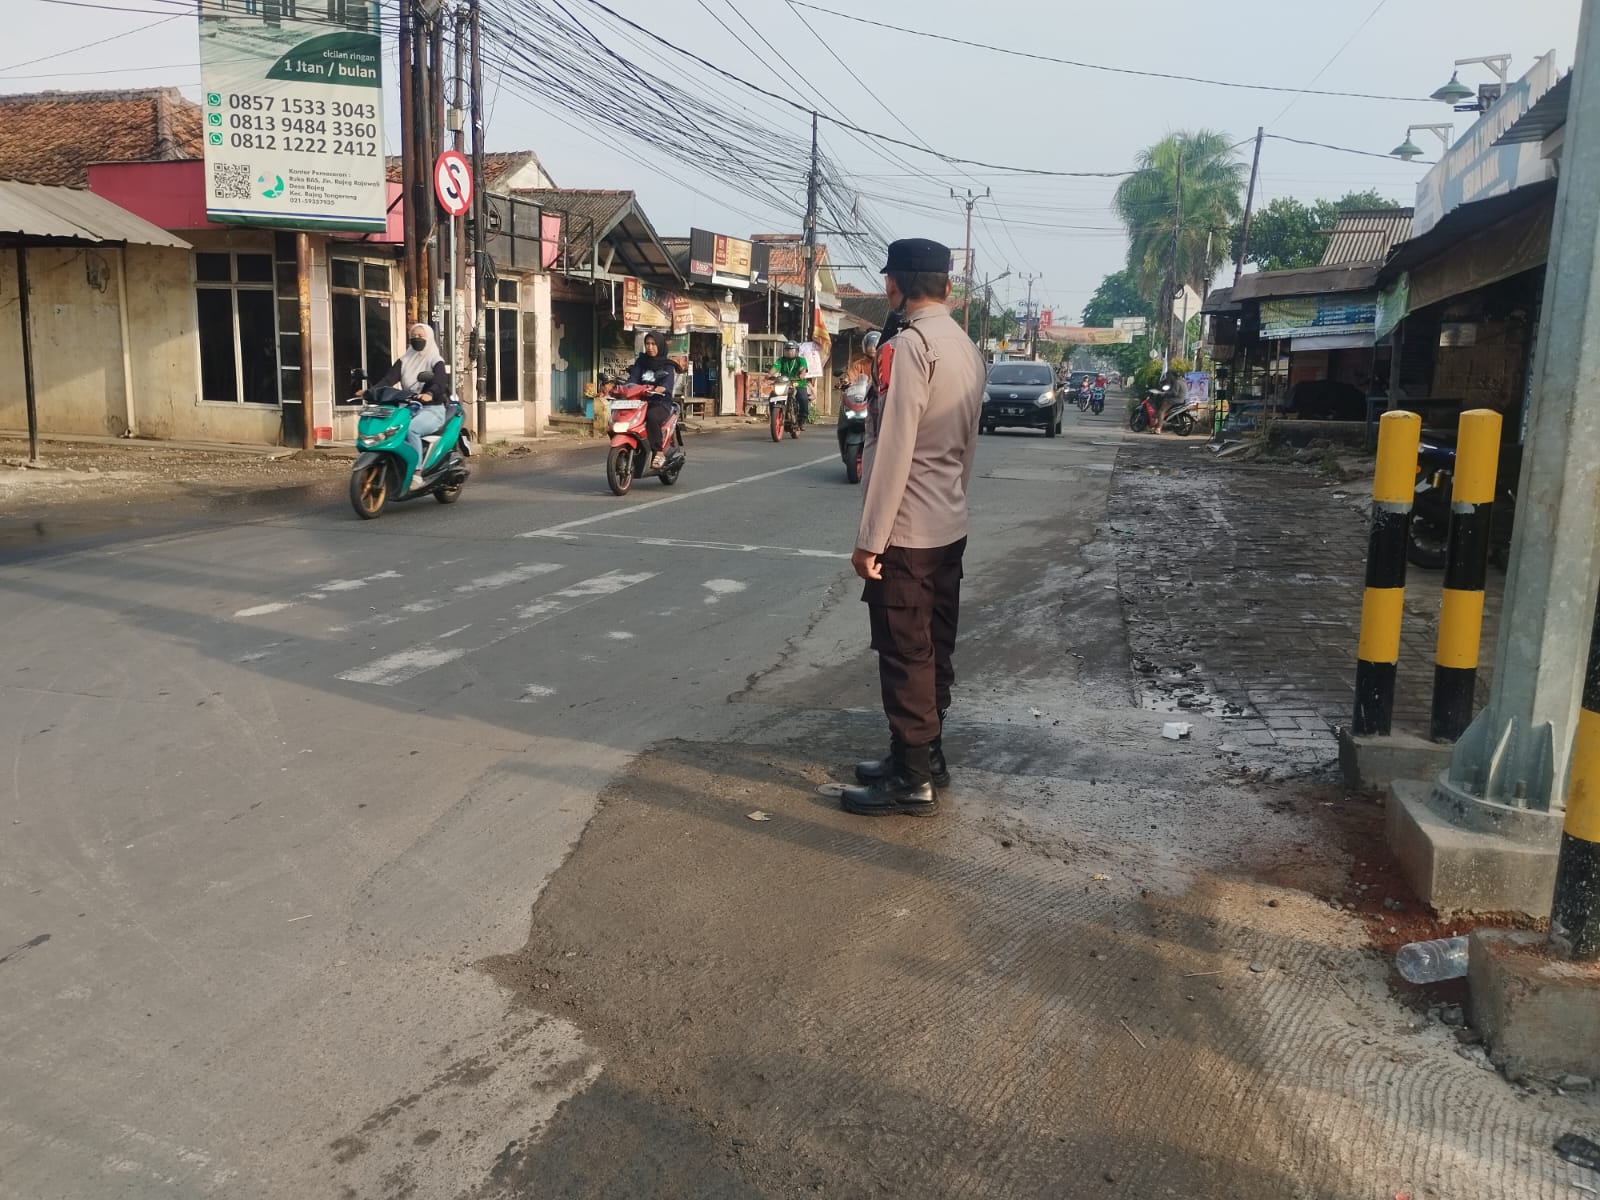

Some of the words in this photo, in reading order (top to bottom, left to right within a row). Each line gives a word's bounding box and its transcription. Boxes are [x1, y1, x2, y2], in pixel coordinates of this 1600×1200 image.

[323, 50, 348, 59] cicilan
[350, 53, 375, 62] ringan
[284, 60, 292, 71] 1
[296, 61, 324, 74] Jtan
[327, 62, 334, 77] /
[338, 64, 376, 78] bulan
[229, 94, 274, 111] 0857
[281, 97, 326, 115] 1533
[331, 102, 375, 119] 3043
[230, 113, 275, 131] 0813
[281, 117, 326, 135] 9484
[332, 121, 376, 138] 3360
[231, 133, 276, 150] 0812
[283, 137, 327, 154] 1222
[333, 140, 377, 157] 2412
